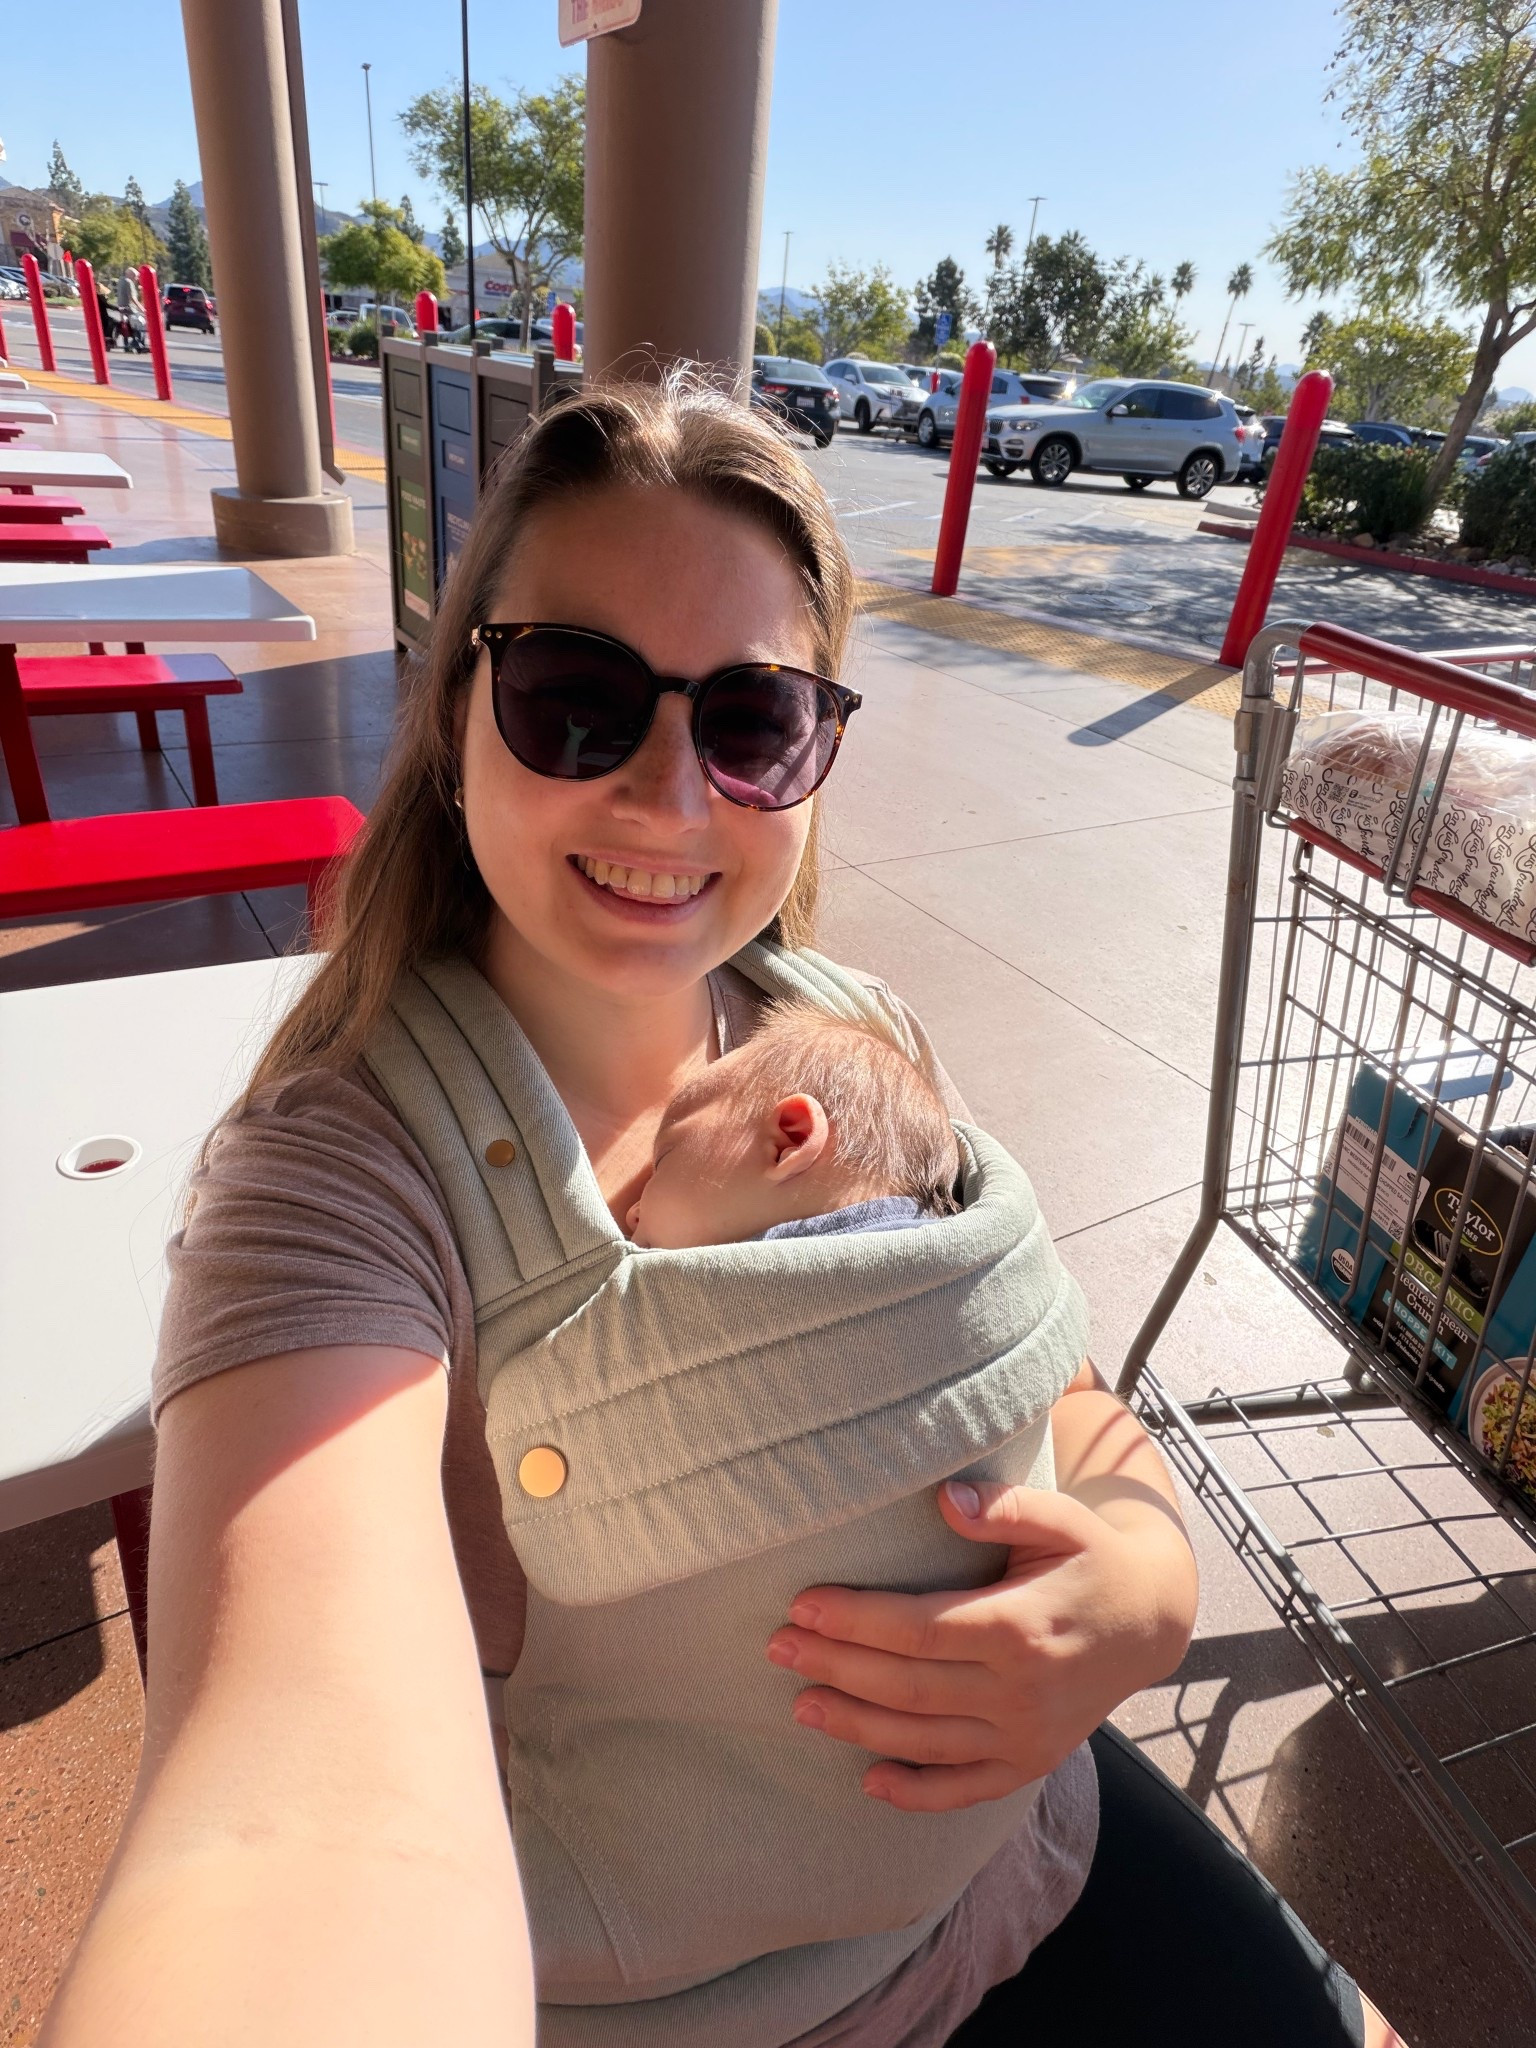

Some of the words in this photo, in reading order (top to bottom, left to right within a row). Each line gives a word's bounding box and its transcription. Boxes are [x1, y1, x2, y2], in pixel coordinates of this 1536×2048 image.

[1447, 1192, 1496, 1242] Tylor
[1406, 1293, 1444, 1335] Crunh
[1434, 1343, 1453, 1362] KIT
